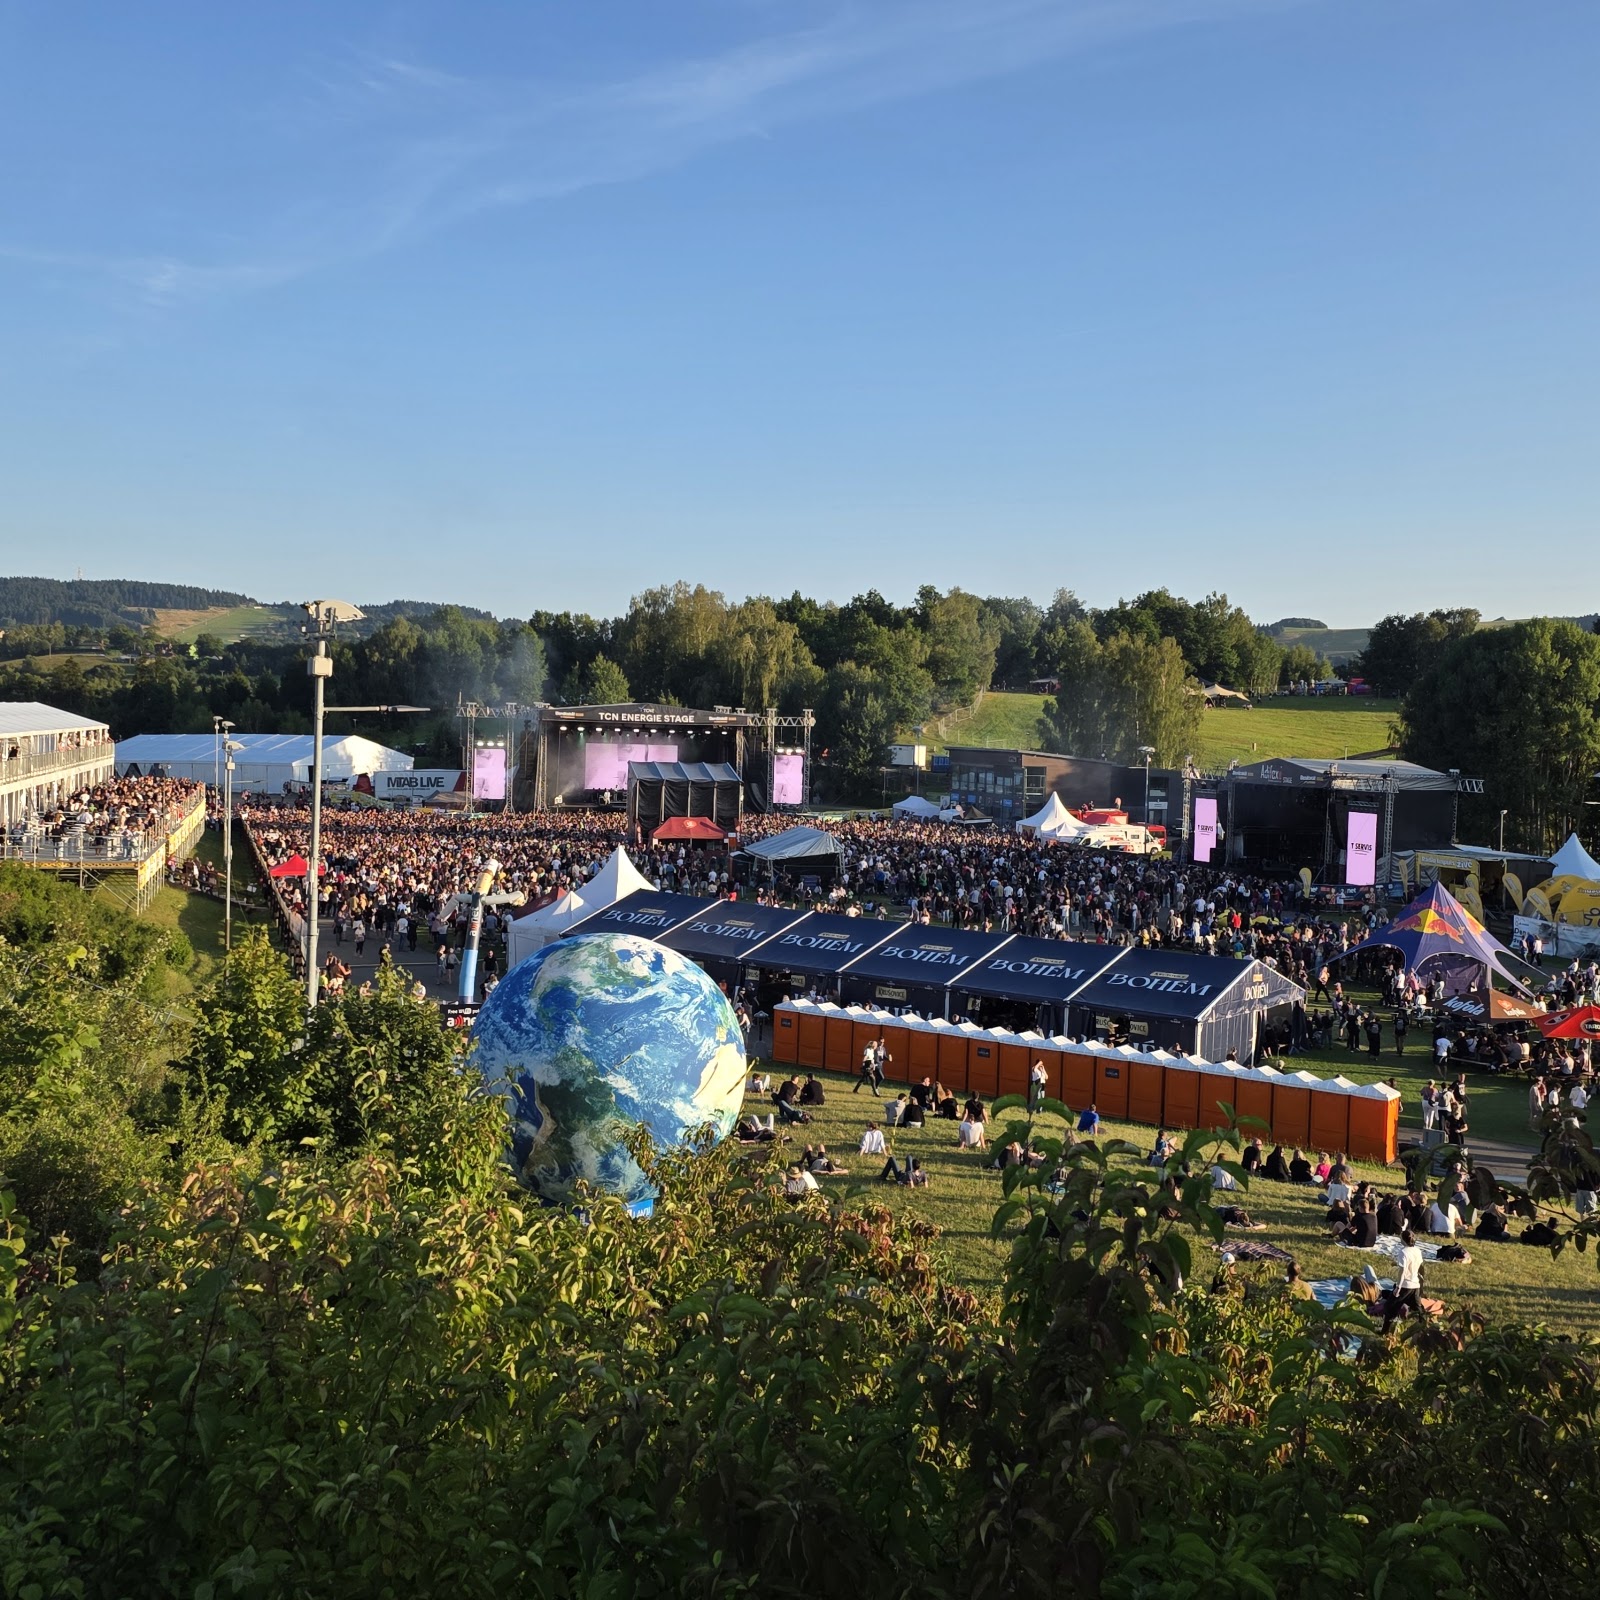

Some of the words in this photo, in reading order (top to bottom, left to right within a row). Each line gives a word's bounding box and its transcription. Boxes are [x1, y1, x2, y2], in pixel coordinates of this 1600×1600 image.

[598, 712, 619, 721] TCN
[621, 713, 662, 722] ENERGIE
[663, 714, 695, 723] STAGE
[387, 776, 418, 788] MTAB
[420, 776, 445, 788] LIVE
[1355, 842, 1373, 852] SERVIS
[987, 959, 1085, 980] BOHÉM
[1106, 973, 1212, 996] BOHÉM
[1442, 995, 1486, 1017] kofola
